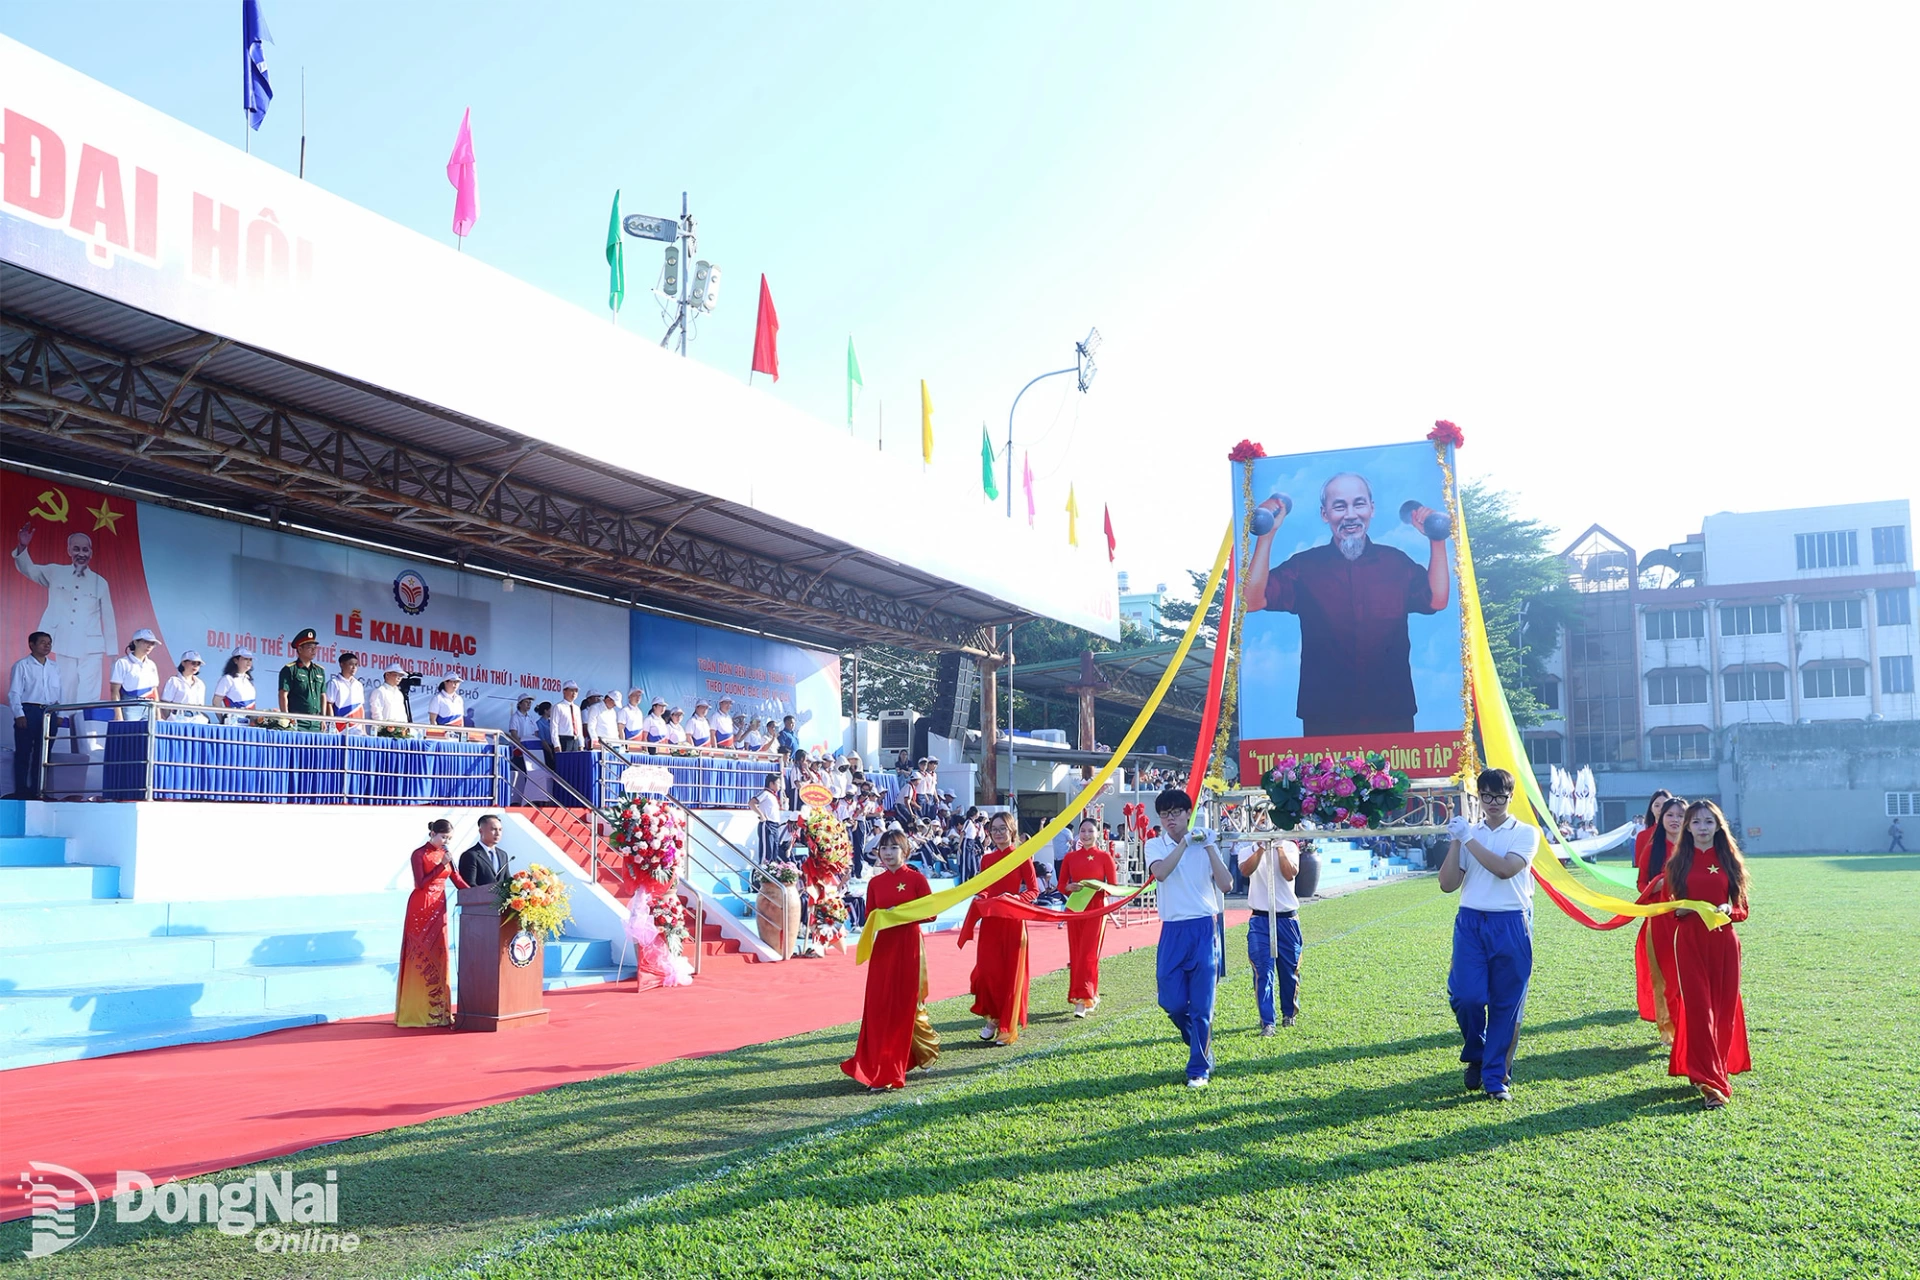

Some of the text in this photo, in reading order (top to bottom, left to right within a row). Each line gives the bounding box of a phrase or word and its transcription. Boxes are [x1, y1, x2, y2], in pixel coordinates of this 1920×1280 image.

[0, 107, 158, 260] ĐẠI
[207, 629, 231, 653] ĐẠI
[260, 634, 285, 657] THỂ
[490, 669, 508, 687] THỨ
[520, 673, 540, 690] NĂM
[542, 678, 562, 693] 2026
[335, 608, 477, 659] LỄ KHAI MẠC
[1381, 745, 1421, 770] CŨNG
